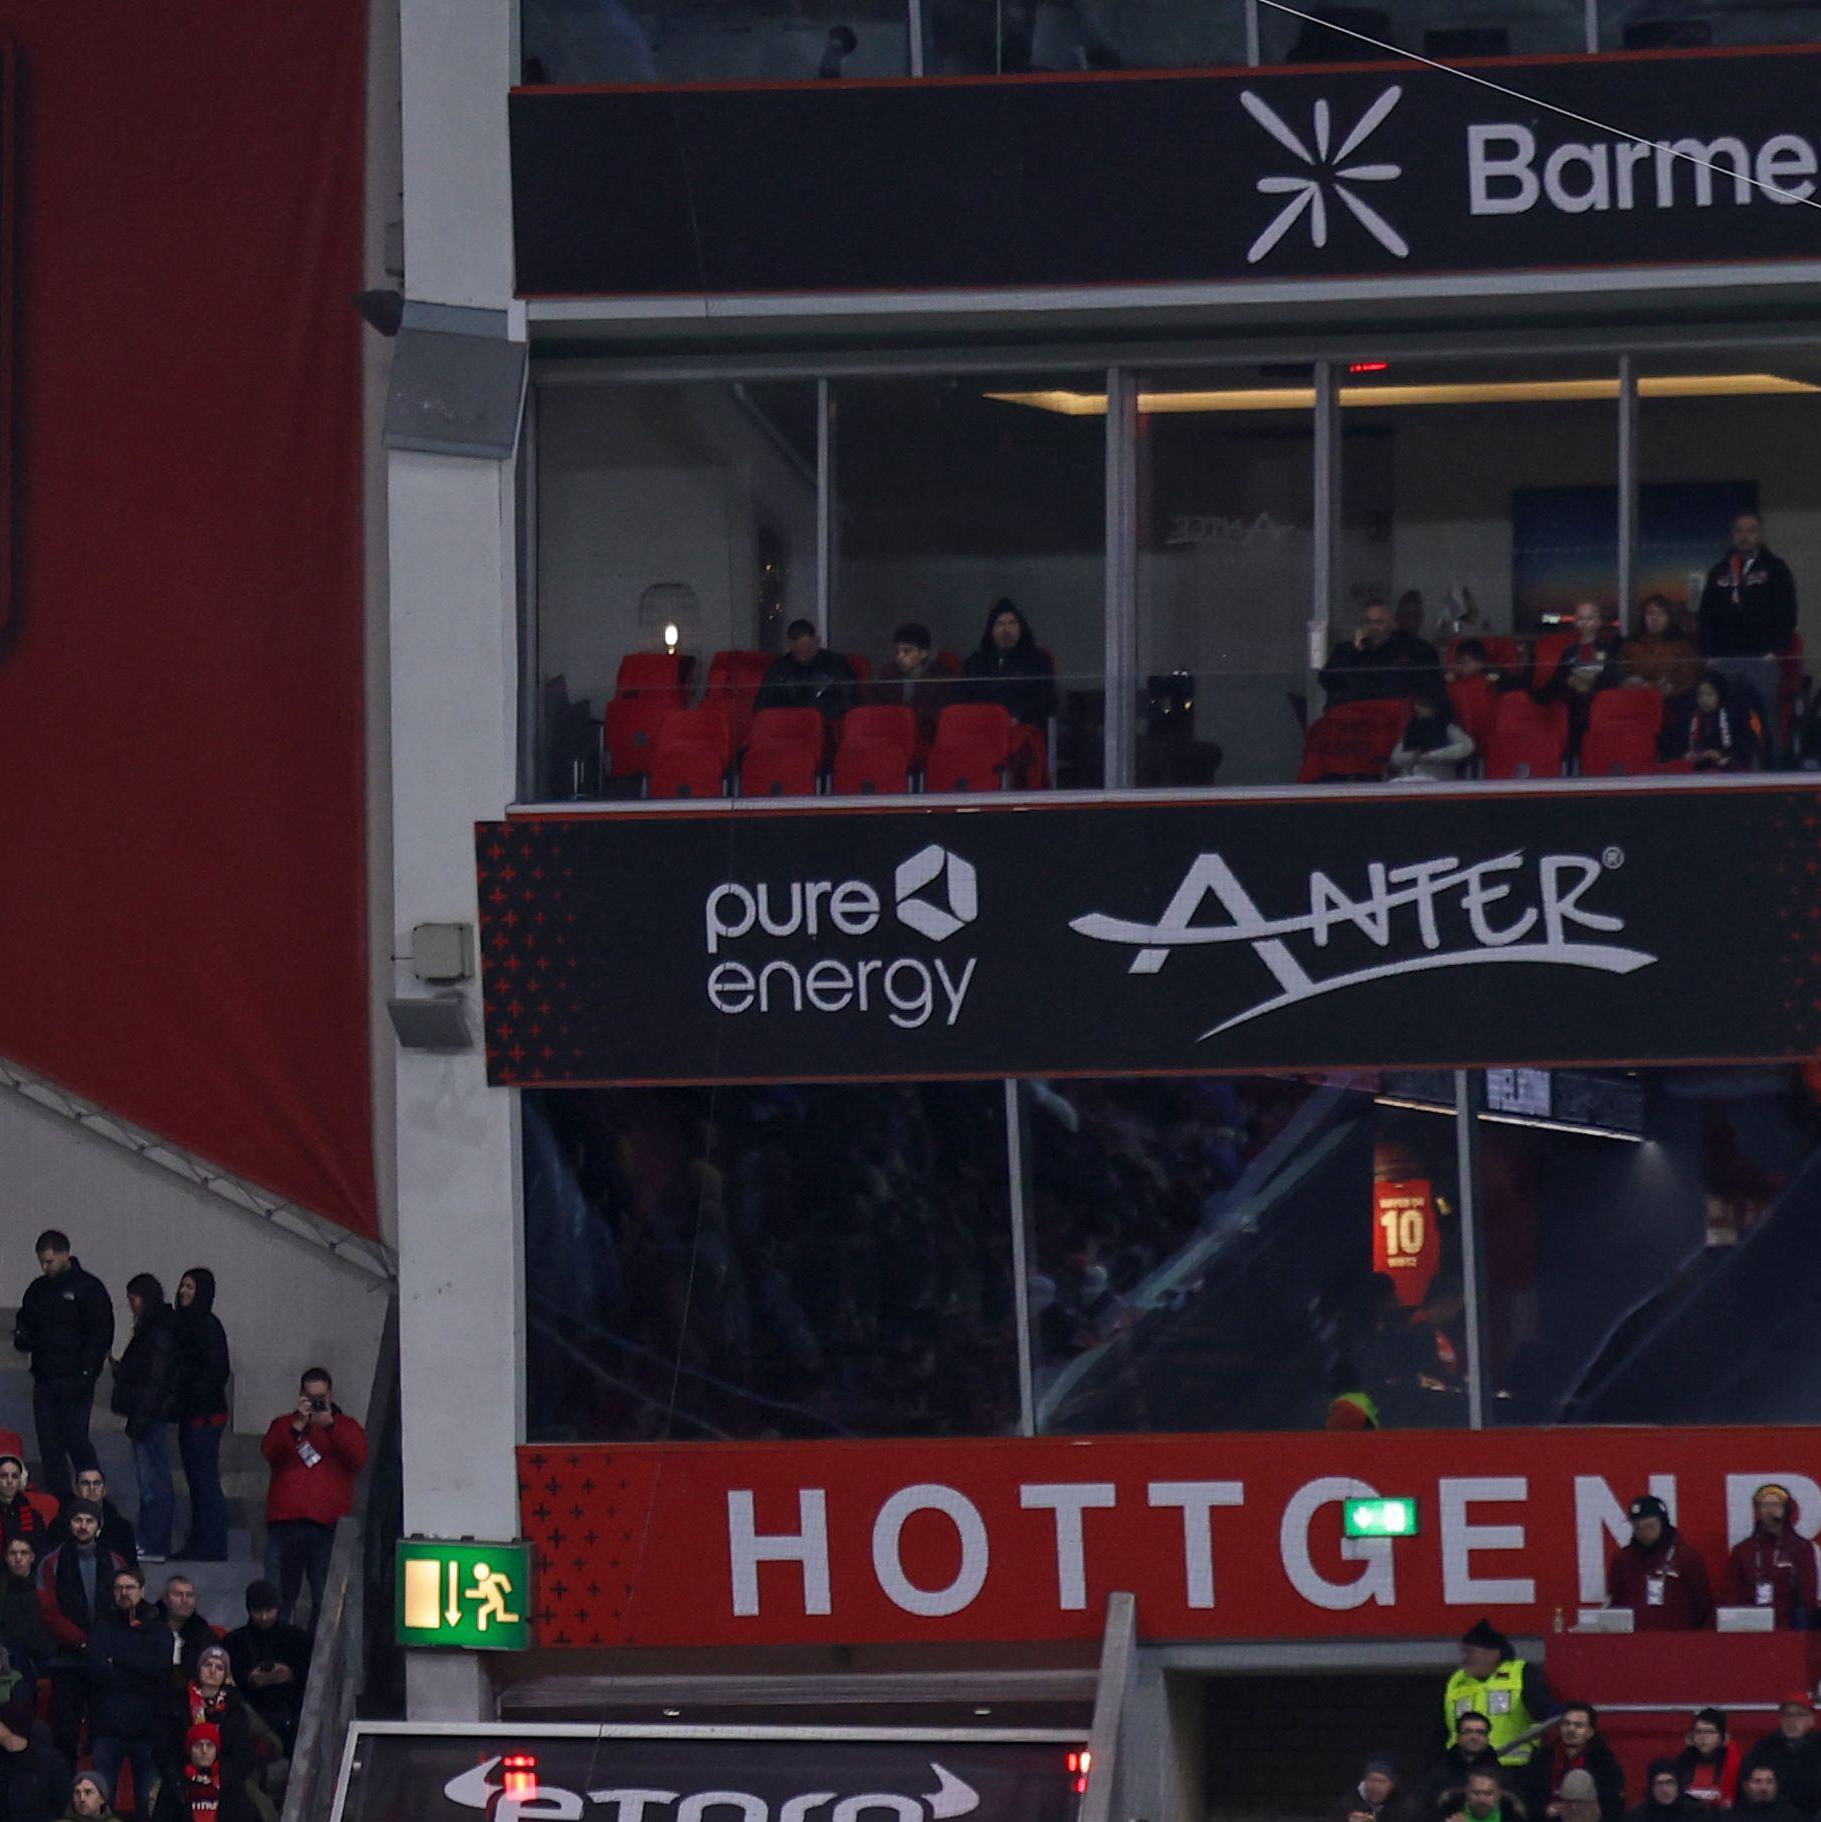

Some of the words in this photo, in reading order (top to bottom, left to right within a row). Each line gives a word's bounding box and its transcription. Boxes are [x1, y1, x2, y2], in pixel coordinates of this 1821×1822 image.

[705, 878, 881, 953] pure
[705, 955, 978, 1029] energy
[1380, 1210, 1425, 1256] 10
